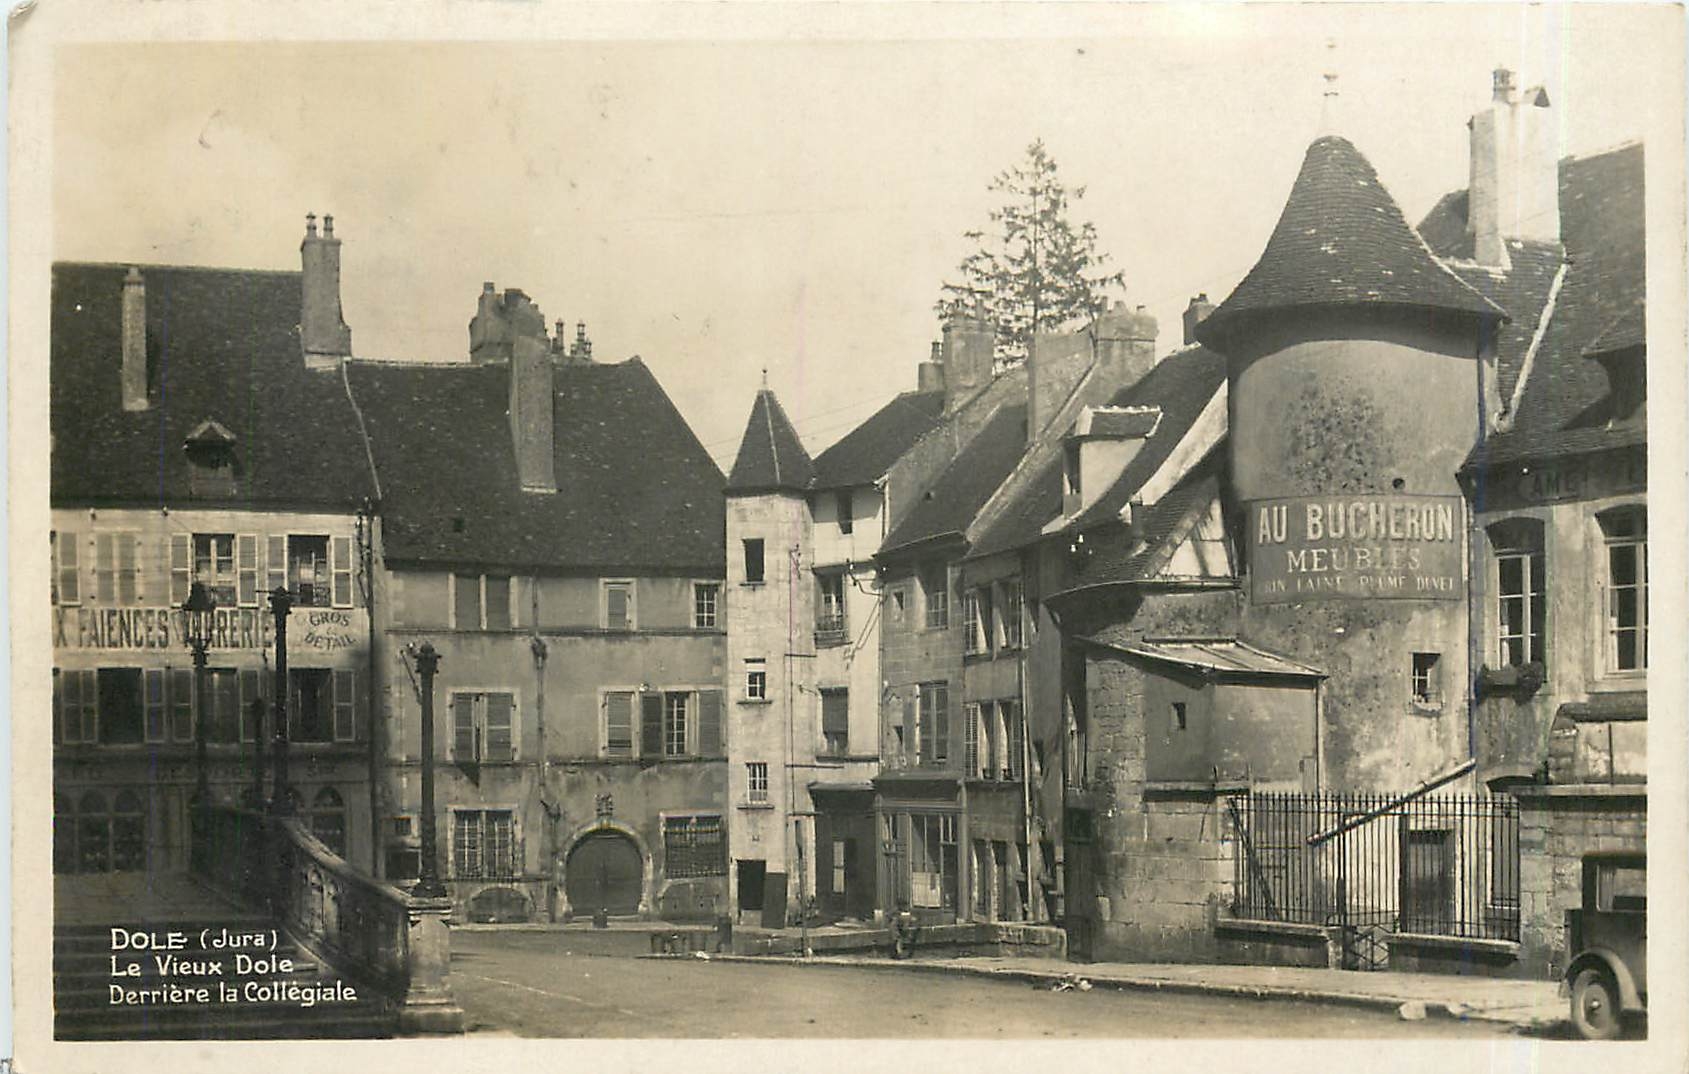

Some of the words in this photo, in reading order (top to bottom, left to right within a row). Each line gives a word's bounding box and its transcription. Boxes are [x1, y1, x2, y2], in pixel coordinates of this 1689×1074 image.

[1258, 504, 1288, 545] AU
[1306, 500, 1454, 543] BUCHERON
[1287, 547, 1421, 573] MEUBLES
[78, 608, 168, 648] FAIENCES
[309, 611, 352, 627] GROS
[304, 632, 358, 650] DETAIL
